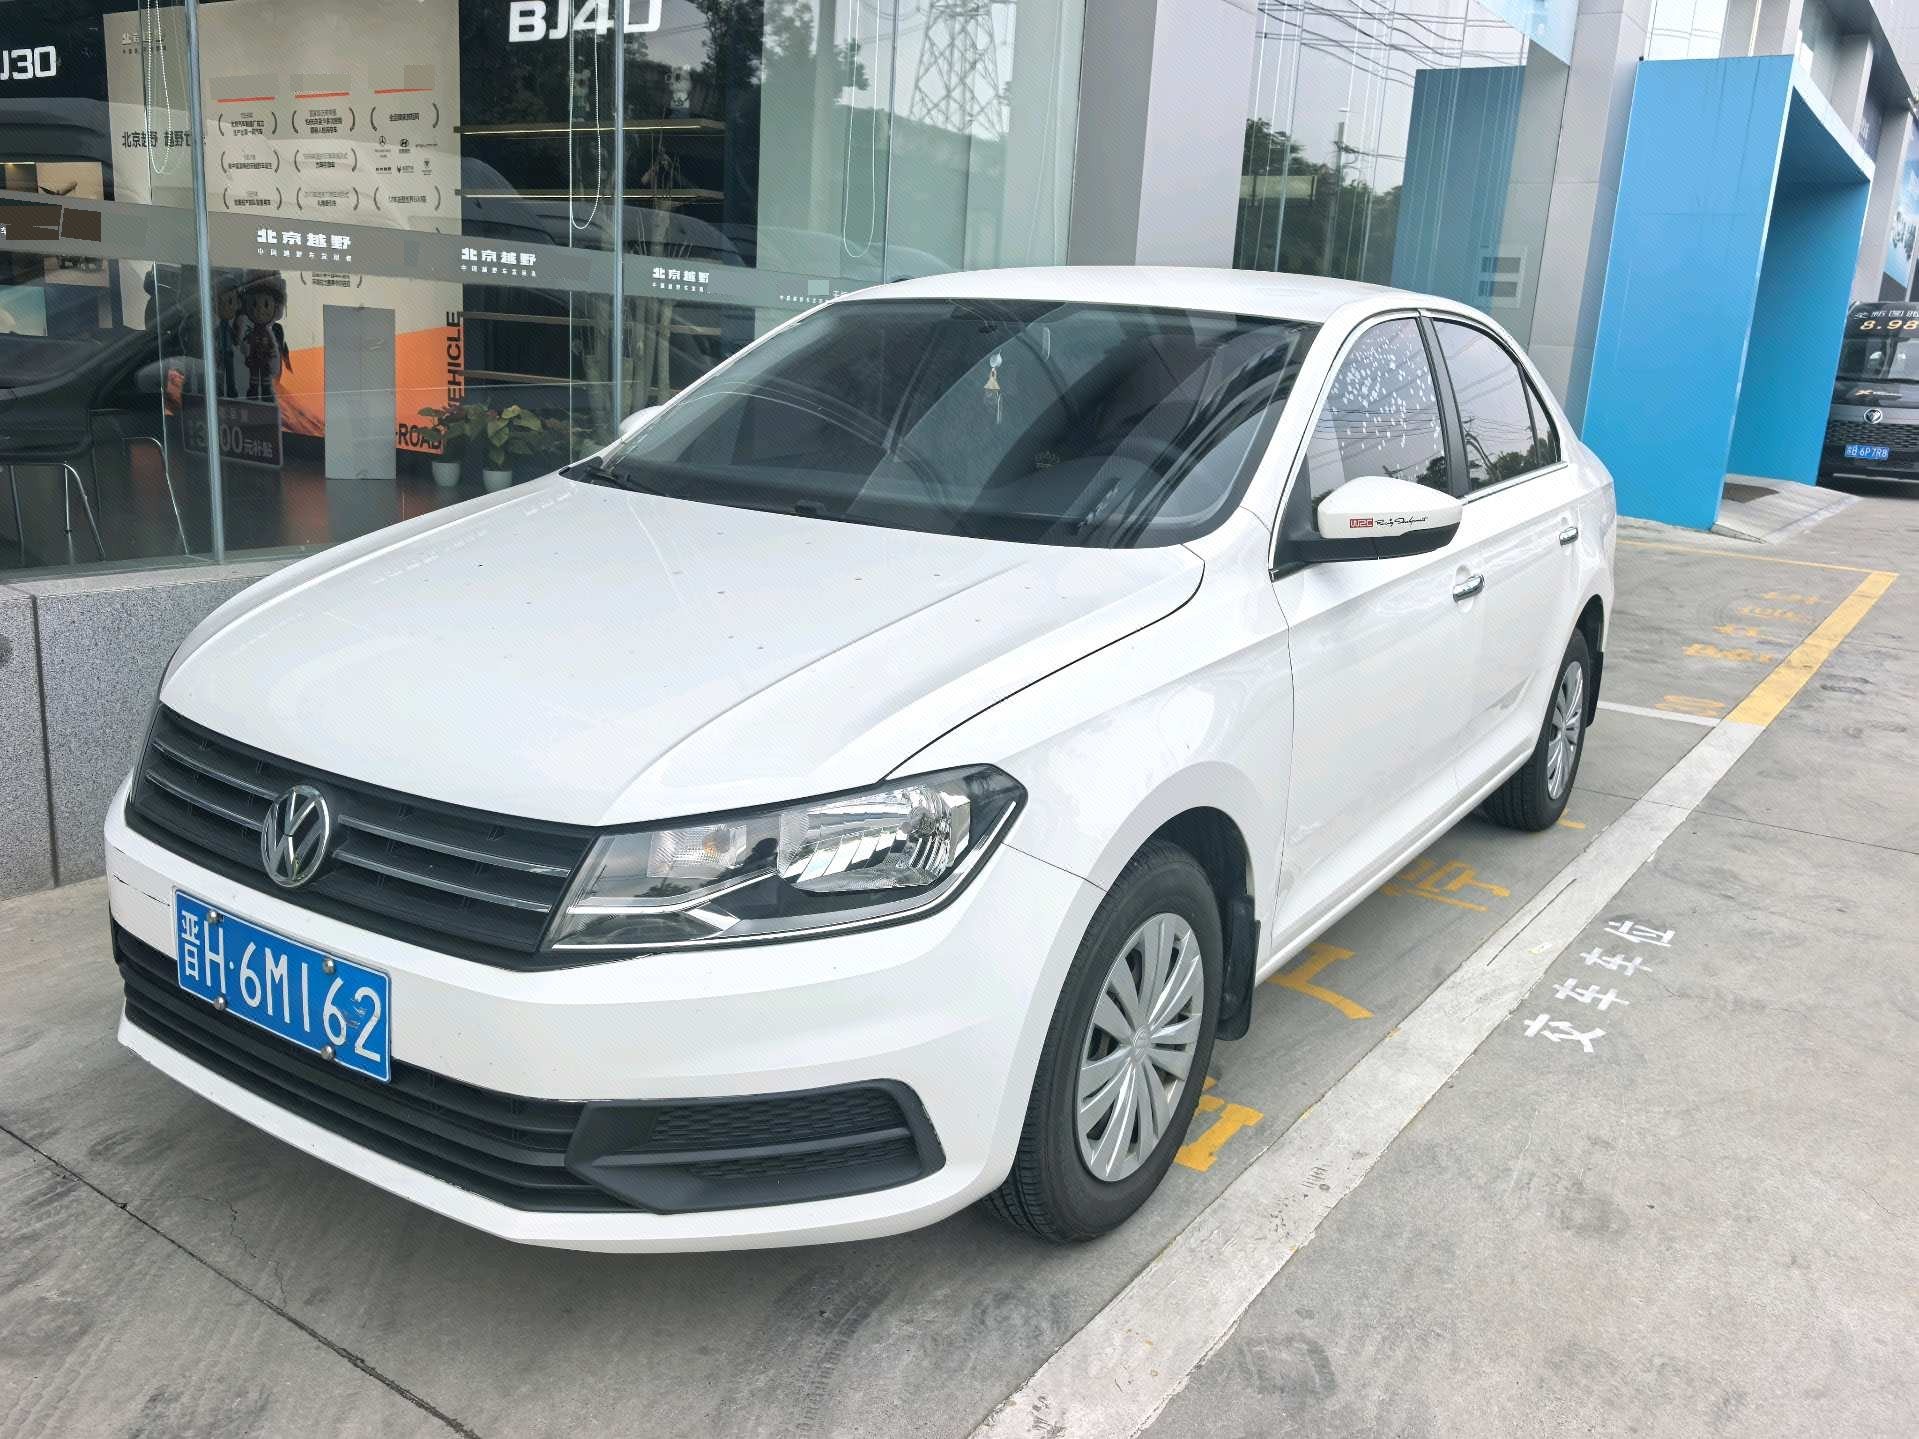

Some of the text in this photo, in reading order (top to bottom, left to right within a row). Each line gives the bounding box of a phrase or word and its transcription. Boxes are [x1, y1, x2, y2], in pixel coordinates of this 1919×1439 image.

[508, 0, 662, 43] BJ40
[257, 228, 351, 250] 北京越野
[461, 247, 536, 266] 北京越野
[652, 267, 710, 284] 北京越野
[446, 311, 463, 408] EHICLE
